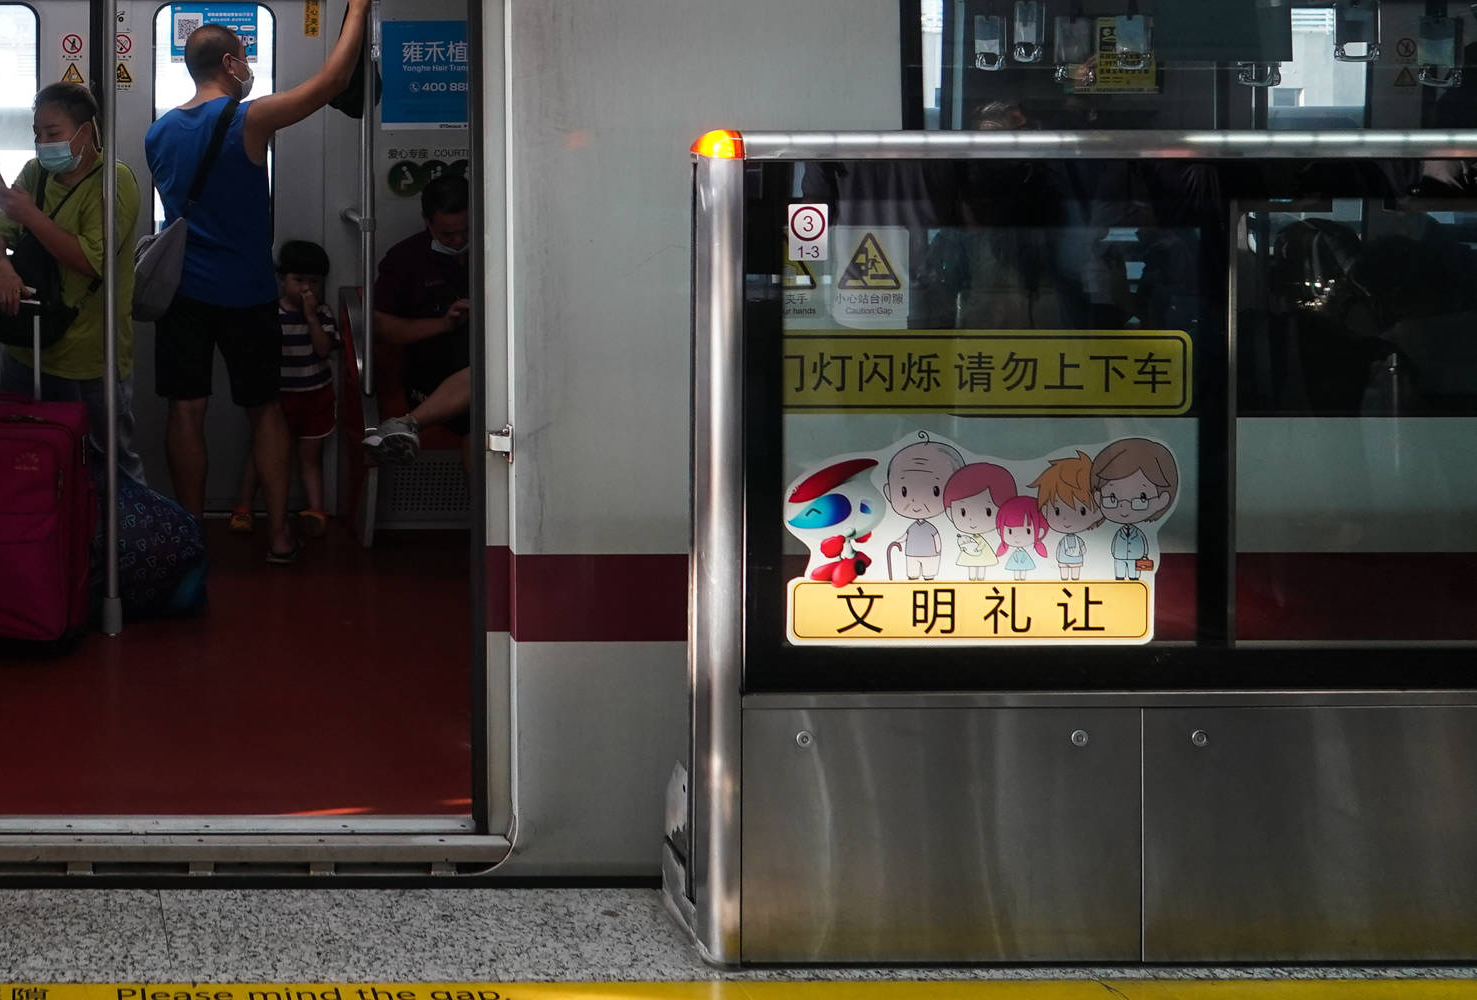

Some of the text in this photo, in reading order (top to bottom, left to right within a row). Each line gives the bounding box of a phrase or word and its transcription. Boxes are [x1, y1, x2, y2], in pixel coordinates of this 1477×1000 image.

[402, 40, 469, 63] 雍禾植
[422, 82, 447, 91] 400
[388, 149, 428, 159] 爱心专座
[803, 215, 814, 232] 3
[798, 246, 820, 258] 1-3
[954, 351, 1174, 393] 请勿上下车
[837, 586, 1106, 635] 文明礼让
[117, 987, 234, 1000] Please
[248, 986, 341, 1000] mind
[355, 986, 416, 1000] the
